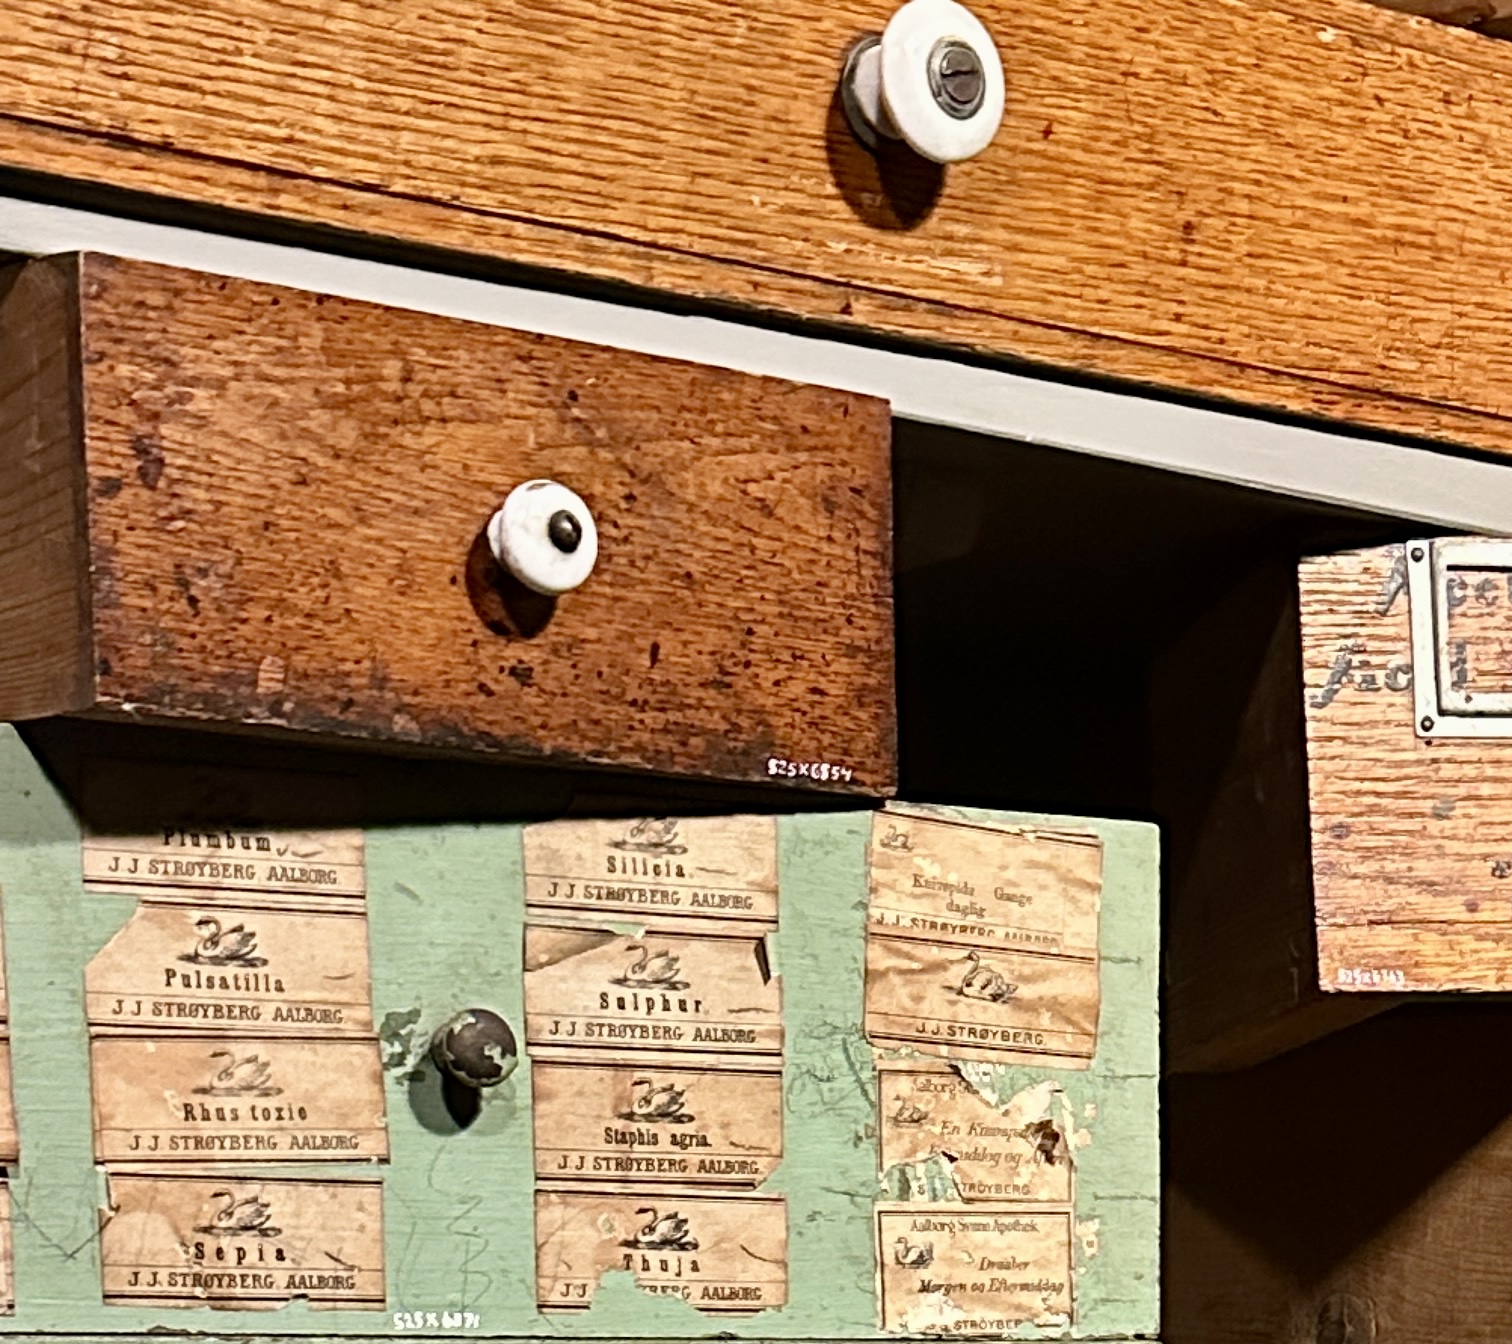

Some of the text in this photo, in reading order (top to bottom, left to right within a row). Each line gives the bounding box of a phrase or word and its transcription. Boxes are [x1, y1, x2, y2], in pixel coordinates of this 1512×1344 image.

[163, 830, 271, 852] Plumbum
[267, 866, 337, 885] AALBORG
[690, 892, 753, 909] AALBORG
[164, 968, 285, 992] Pulsatilla
[152, 1002, 261, 1021] STRØYBERG
[272, 1008, 343, 1023] AALBORG
[585, 1022, 684, 1040] STRØYBERG
[692, 1027, 756, 1043] AALBORG
[183, 1104, 239, 1122] Rhus
[169, 1135, 278, 1150] STRØYBERG
[289, 1135, 359, 1150] AALBORG
[604, 1128, 659, 1148] Staphis
[697, 1159, 760, 1174] AALBORG
[194, 1242, 286, 1264] Sepia
[623, 1254, 700, 1276] Thuja
[285, 1274, 356, 1289] AALBORG
[700, 1288, 762, 1300] AALBORG
